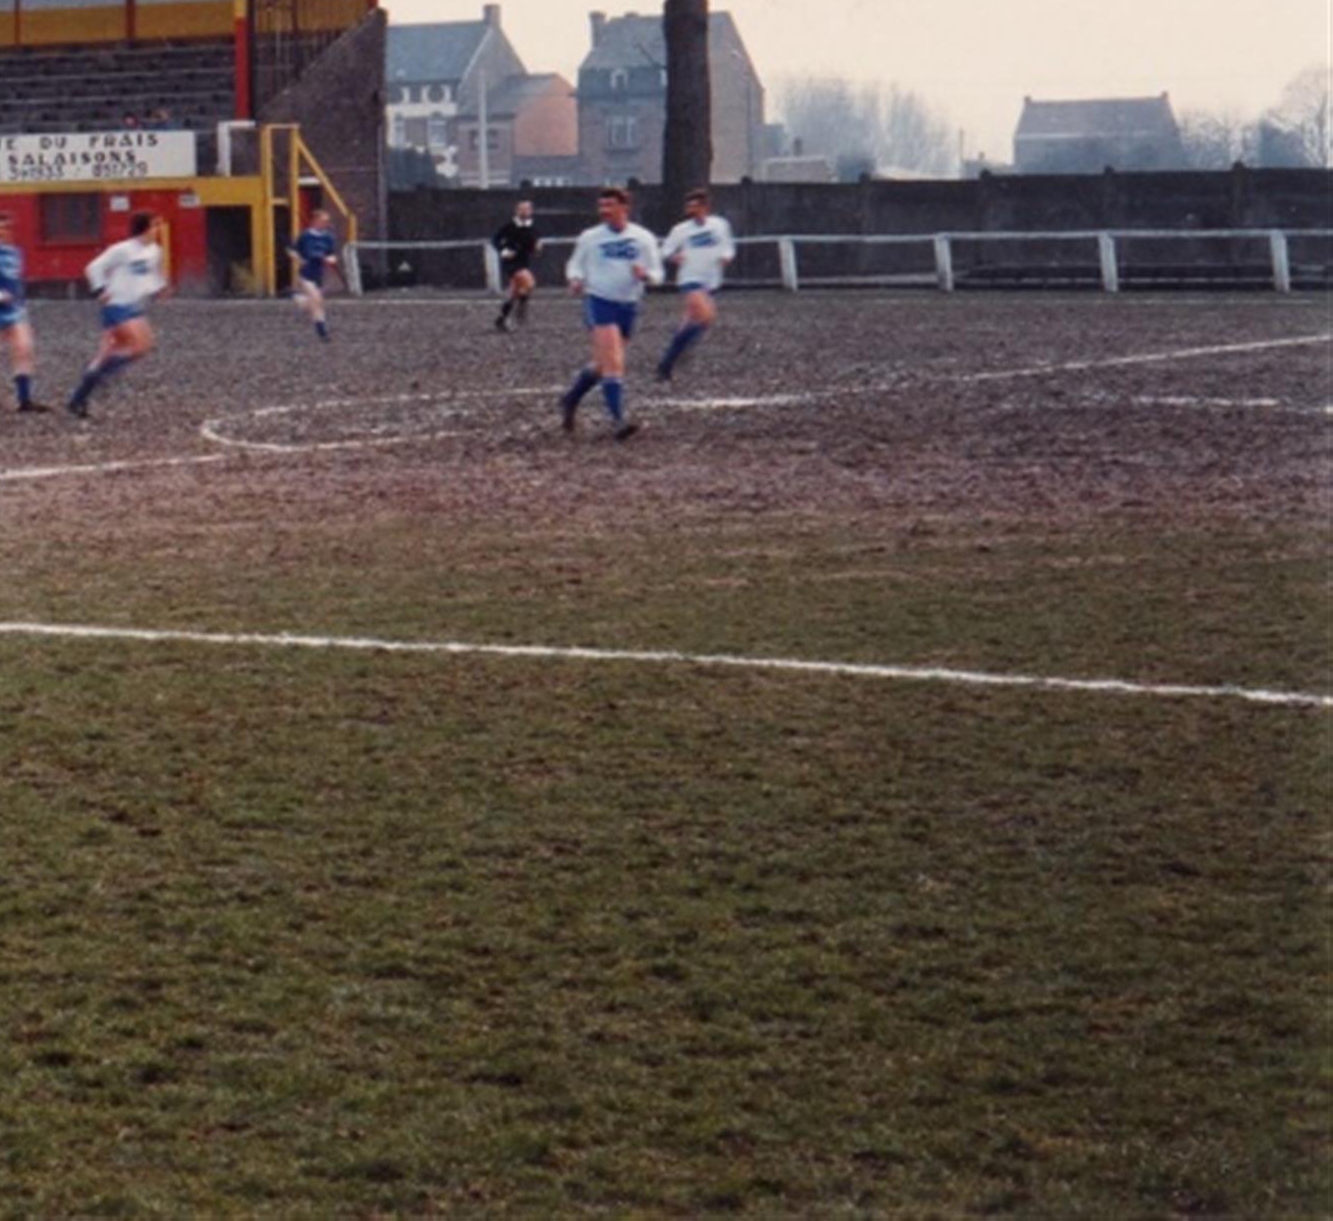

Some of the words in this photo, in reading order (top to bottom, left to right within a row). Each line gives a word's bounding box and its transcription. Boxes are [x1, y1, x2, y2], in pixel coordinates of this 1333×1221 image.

[39, 136, 68, 150] DU
[89, 133, 159, 148] FRAIS
[7, 151, 136, 166] SALAISONS
